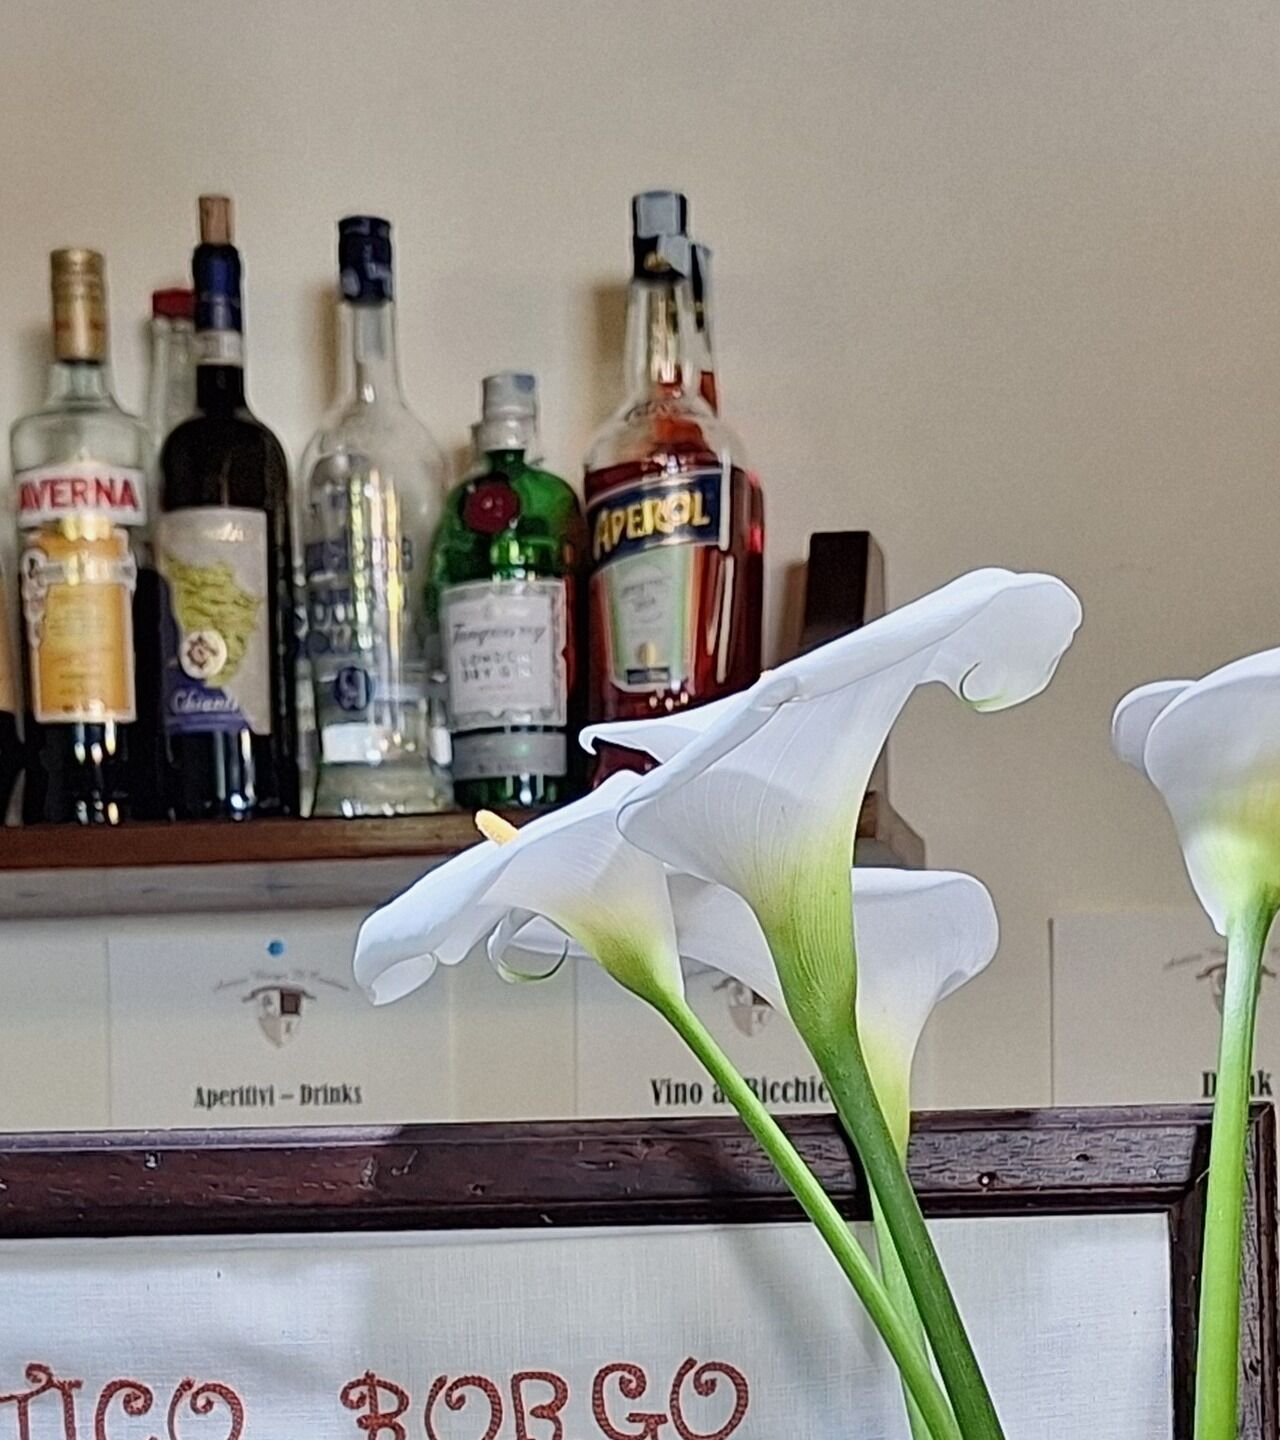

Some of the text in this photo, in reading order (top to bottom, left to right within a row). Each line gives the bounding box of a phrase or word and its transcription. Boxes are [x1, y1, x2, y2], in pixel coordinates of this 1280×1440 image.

[21, 478, 138, 511] AVERNA
[593, 490, 711, 560] APEROL
[194, 1084, 275, 1111] Aperitivi
[299, 1083, 363, 1107] Drinks
[650, 1078, 703, 1107] Vino
[744, 1075, 831, 1104] Bicchie
